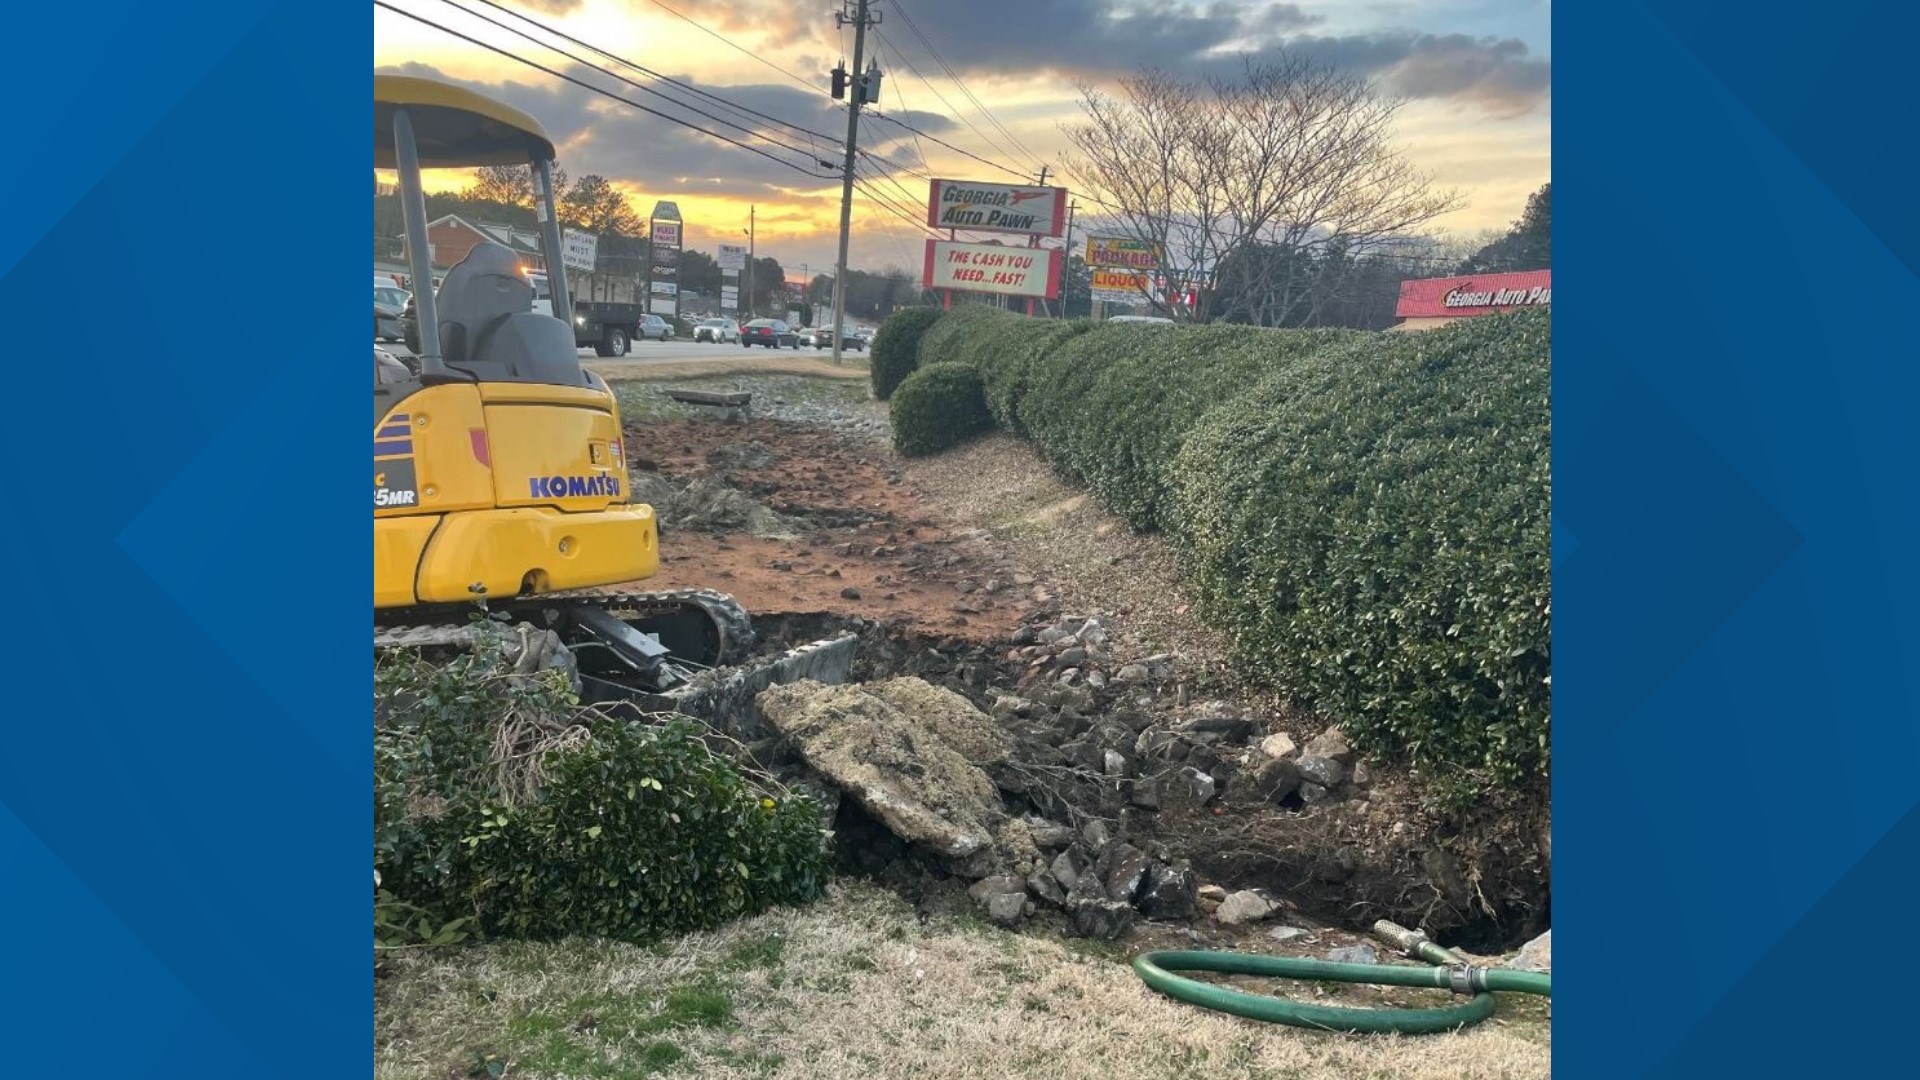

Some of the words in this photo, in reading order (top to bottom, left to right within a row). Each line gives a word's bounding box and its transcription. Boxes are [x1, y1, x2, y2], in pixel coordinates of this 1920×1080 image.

[943, 185, 1009, 206] GEORGIA
[942, 206, 983, 226] AUTO
[986, 210, 1035, 229] PAWN
[570, 245, 589, 255] MUST
[948, 250, 971, 264] THE
[972, 252, 1005, 266] CASH
[1007, 255, 1034, 269] YOU
[1094, 273, 1147, 288] LIQUOR
[1446, 290, 1494, 307] GEORGIA
[1492, 288, 1528, 305] AUTO
[529, 471, 620, 498] KOMATSU
[374, 488, 415, 506] 5MR
